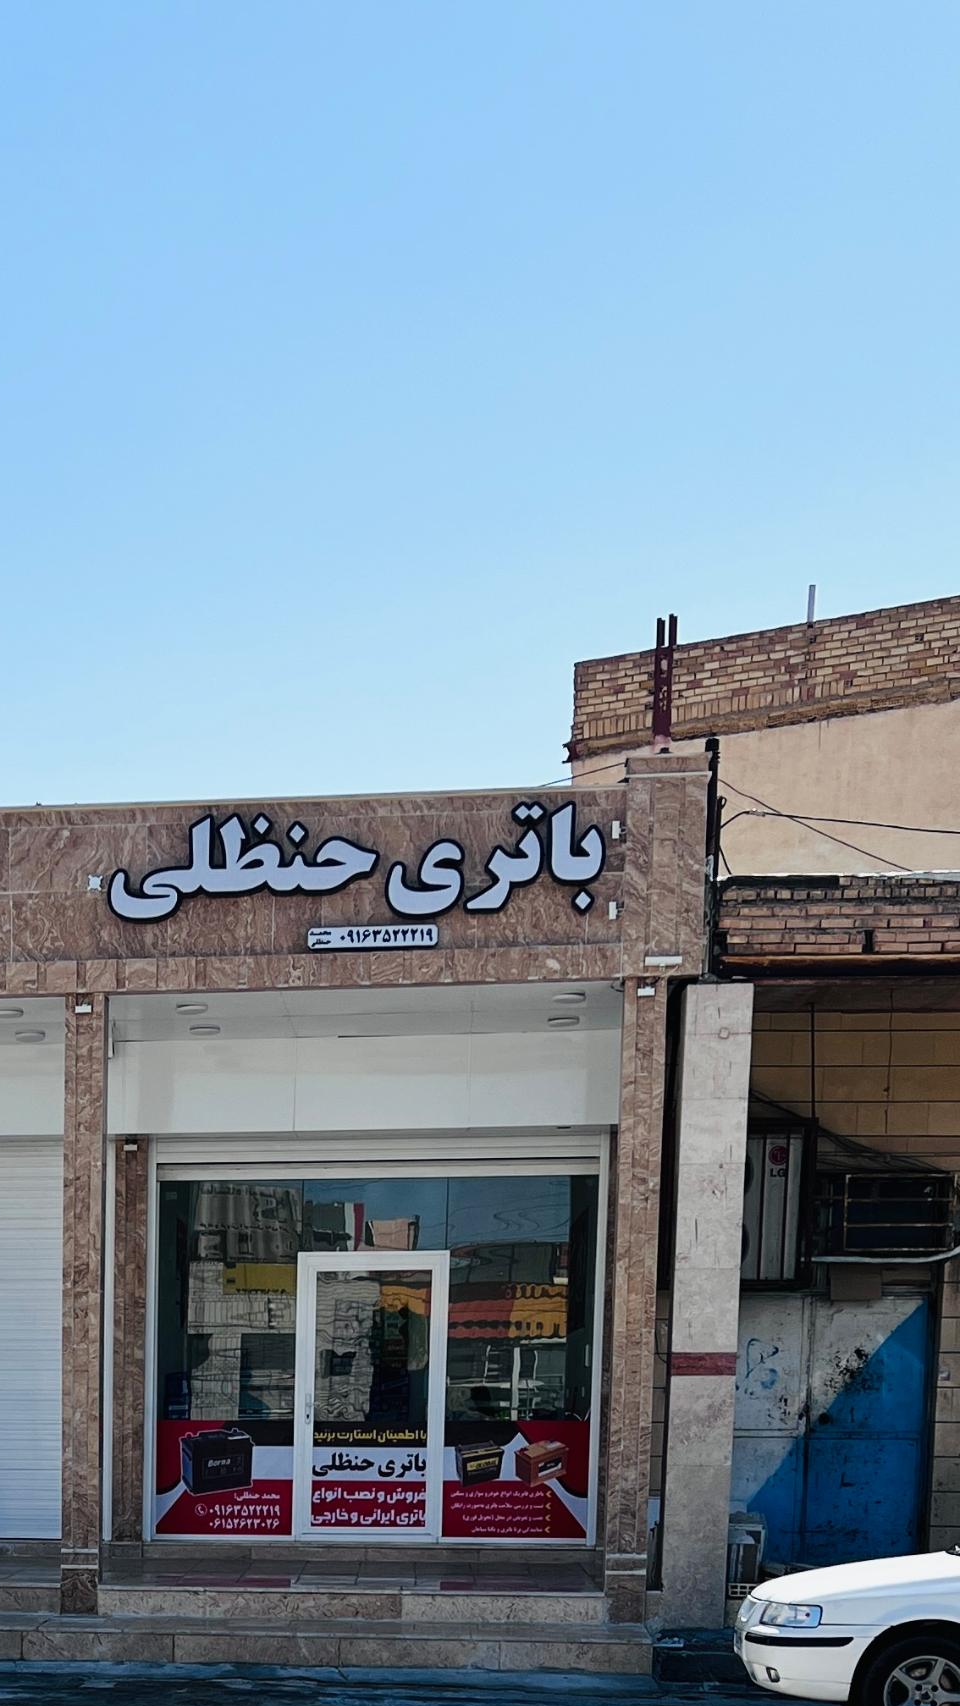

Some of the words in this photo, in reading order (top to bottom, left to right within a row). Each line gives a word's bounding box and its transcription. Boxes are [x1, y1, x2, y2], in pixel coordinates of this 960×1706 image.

[108, 812, 380, 922] حنظلی
[385, 801, 607, 917] باتری
[340, 928, 433, 944] ۰۹۱۶۳۵۲۲۲۱۹
[313, 1429, 336, 1443] بزنید
[336, 1429, 377, 1443] استارت
[378, 1429, 419, 1443] اطمینان
[312, 1452, 375, 1477] حنظلی
[377, 1452, 427, 1478] باتری
[312, 1487, 342, 1503] انواع
[343, 1487, 376, 1503] نصب
[376, 1490, 385, 1503] و
[209, 1504, 281, 1516] ۰۹۱۶۳۵۲۲۲۱۹
[311, 1508, 349, 1524] خارجی
[350, 1511, 358, 1524] و
[360, 1508, 395, 1525] ایرانی
